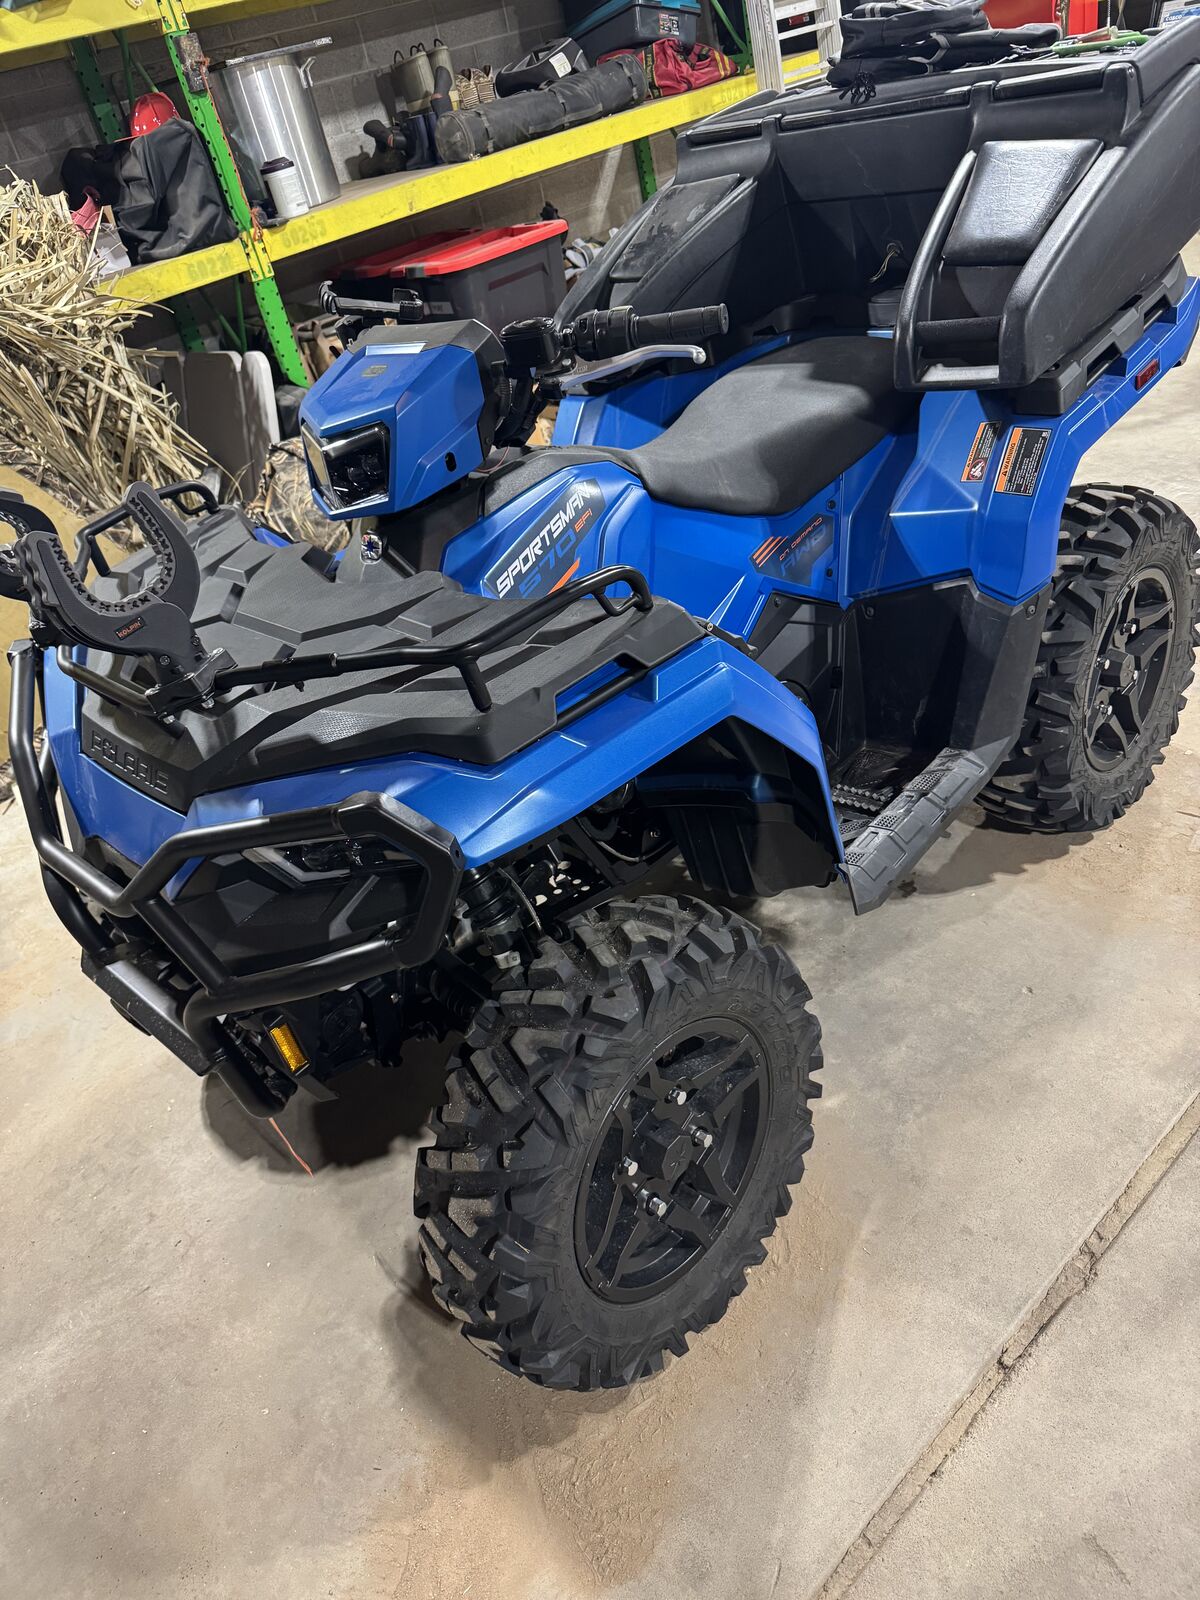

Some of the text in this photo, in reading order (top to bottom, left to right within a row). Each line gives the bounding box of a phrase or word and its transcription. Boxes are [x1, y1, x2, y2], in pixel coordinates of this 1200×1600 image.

[1003, 442, 1016, 470] WARNING
[496, 482, 591, 599] SPORTSMAN
[519, 508, 593, 598] 570 EFI
[117, 621, 142, 639] KOLPIN
[91, 730, 169, 795] POLARIS
